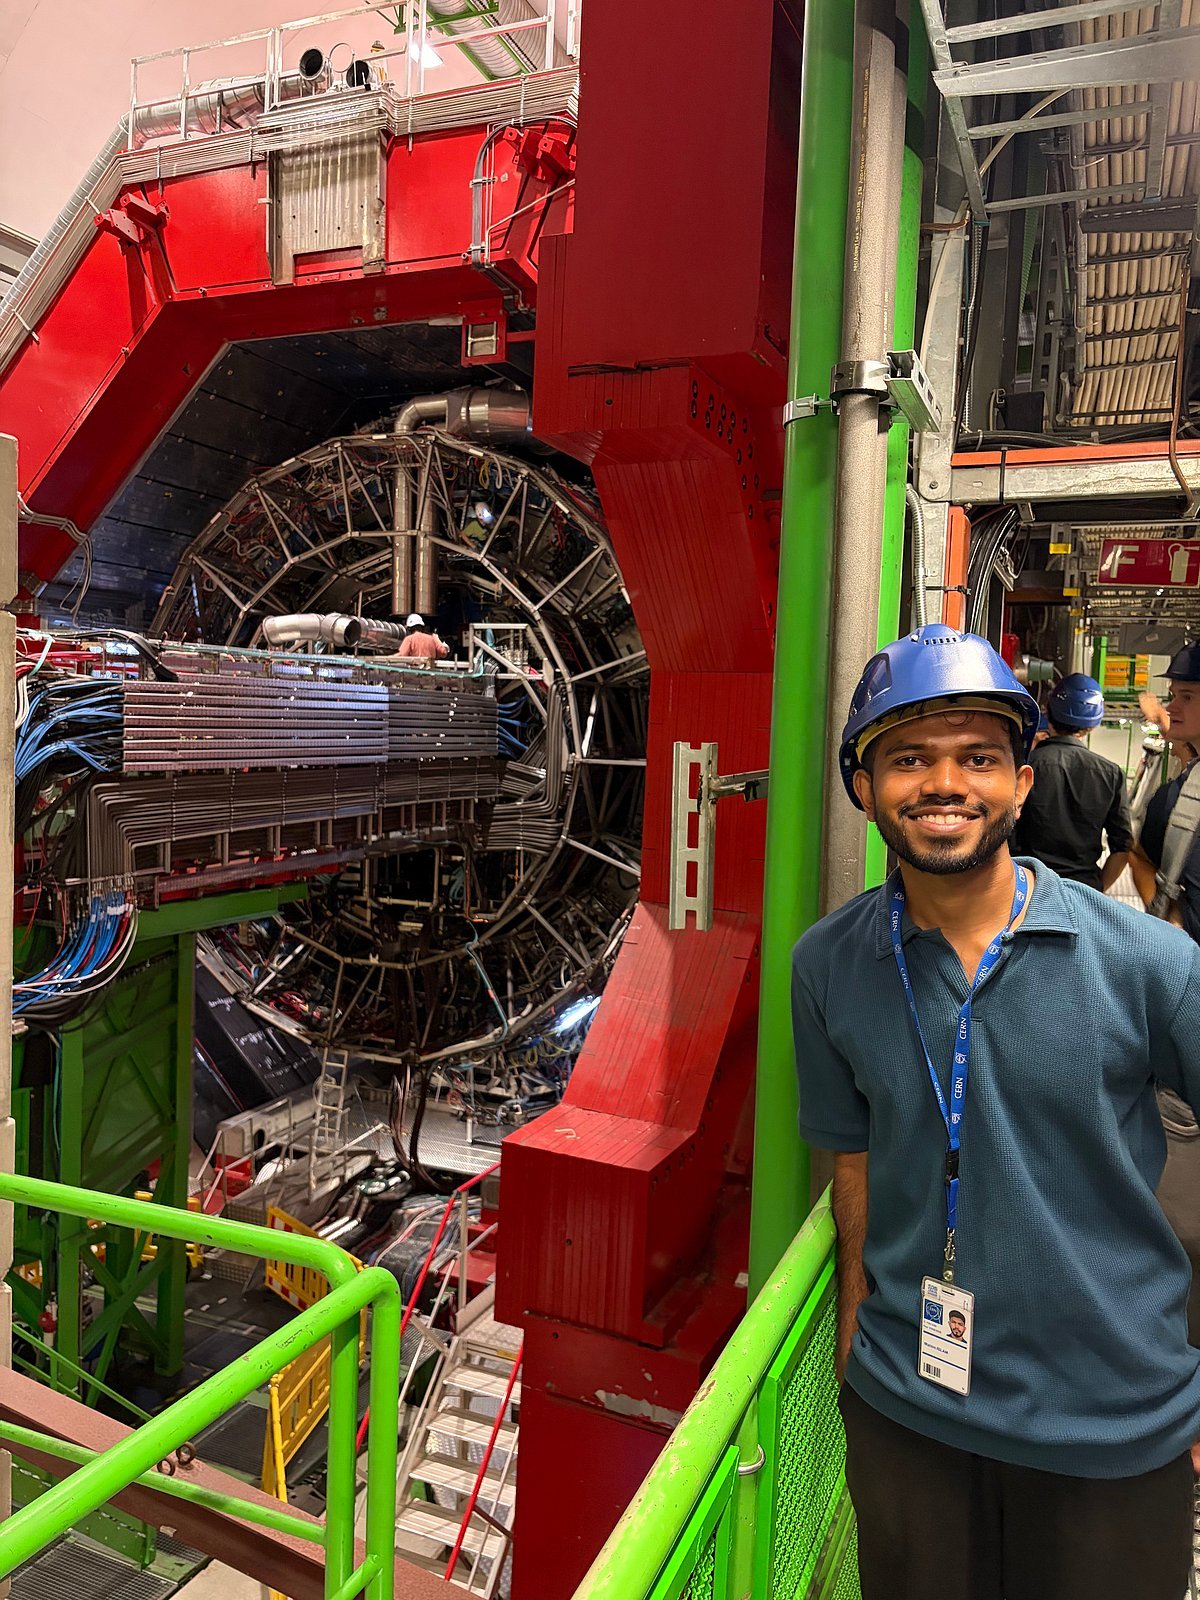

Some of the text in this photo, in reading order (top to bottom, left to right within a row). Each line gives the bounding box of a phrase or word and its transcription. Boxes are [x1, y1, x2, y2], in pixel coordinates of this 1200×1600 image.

[1110, 545, 1140, 578] F
[958, 1017, 967, 1040] CERN
[954, 1076, 963, 1099] CERN
